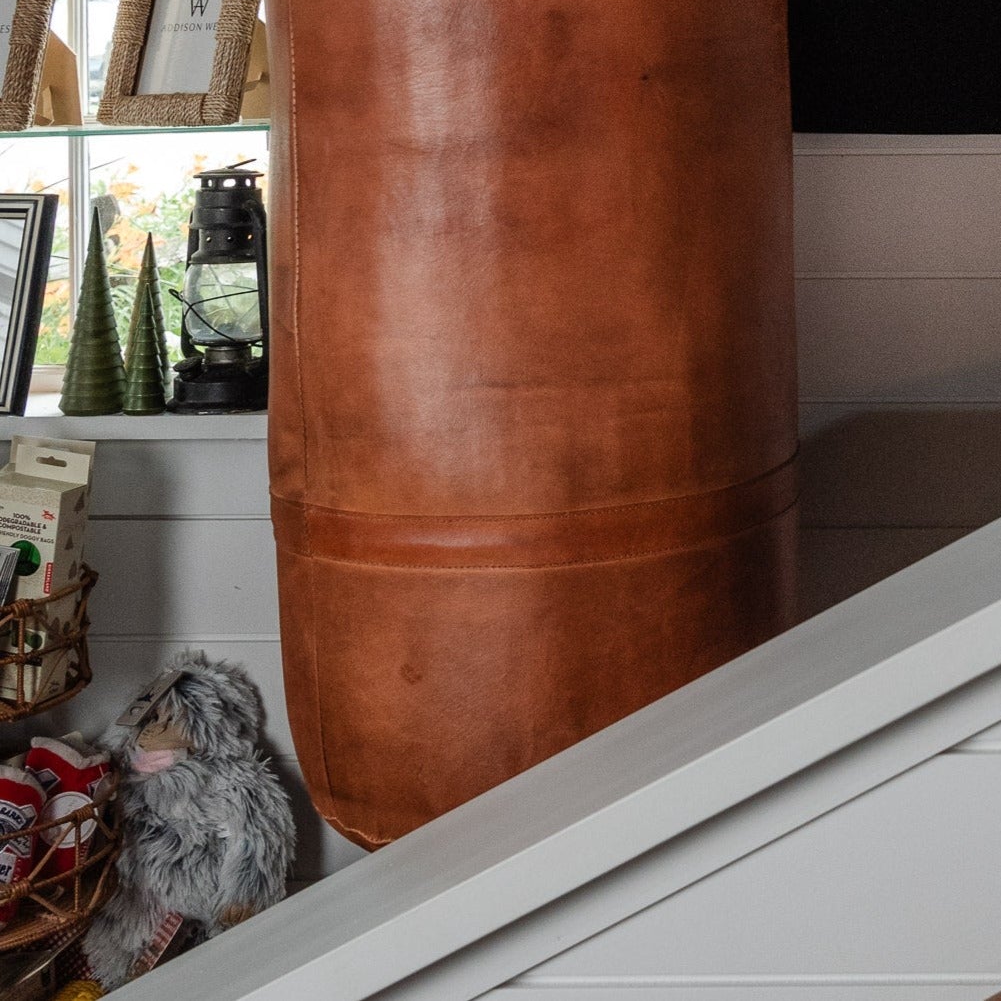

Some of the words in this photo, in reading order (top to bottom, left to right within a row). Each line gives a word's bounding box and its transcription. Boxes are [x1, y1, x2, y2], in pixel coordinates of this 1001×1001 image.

[0, 24, 11, 34] ES
[160, 22, 203, 32] ADDISON
[205, 22, 218, 31] WE
[13, 512, 31, 520] 100%
[0, 516, 42, 529] ODEGRADABLE
